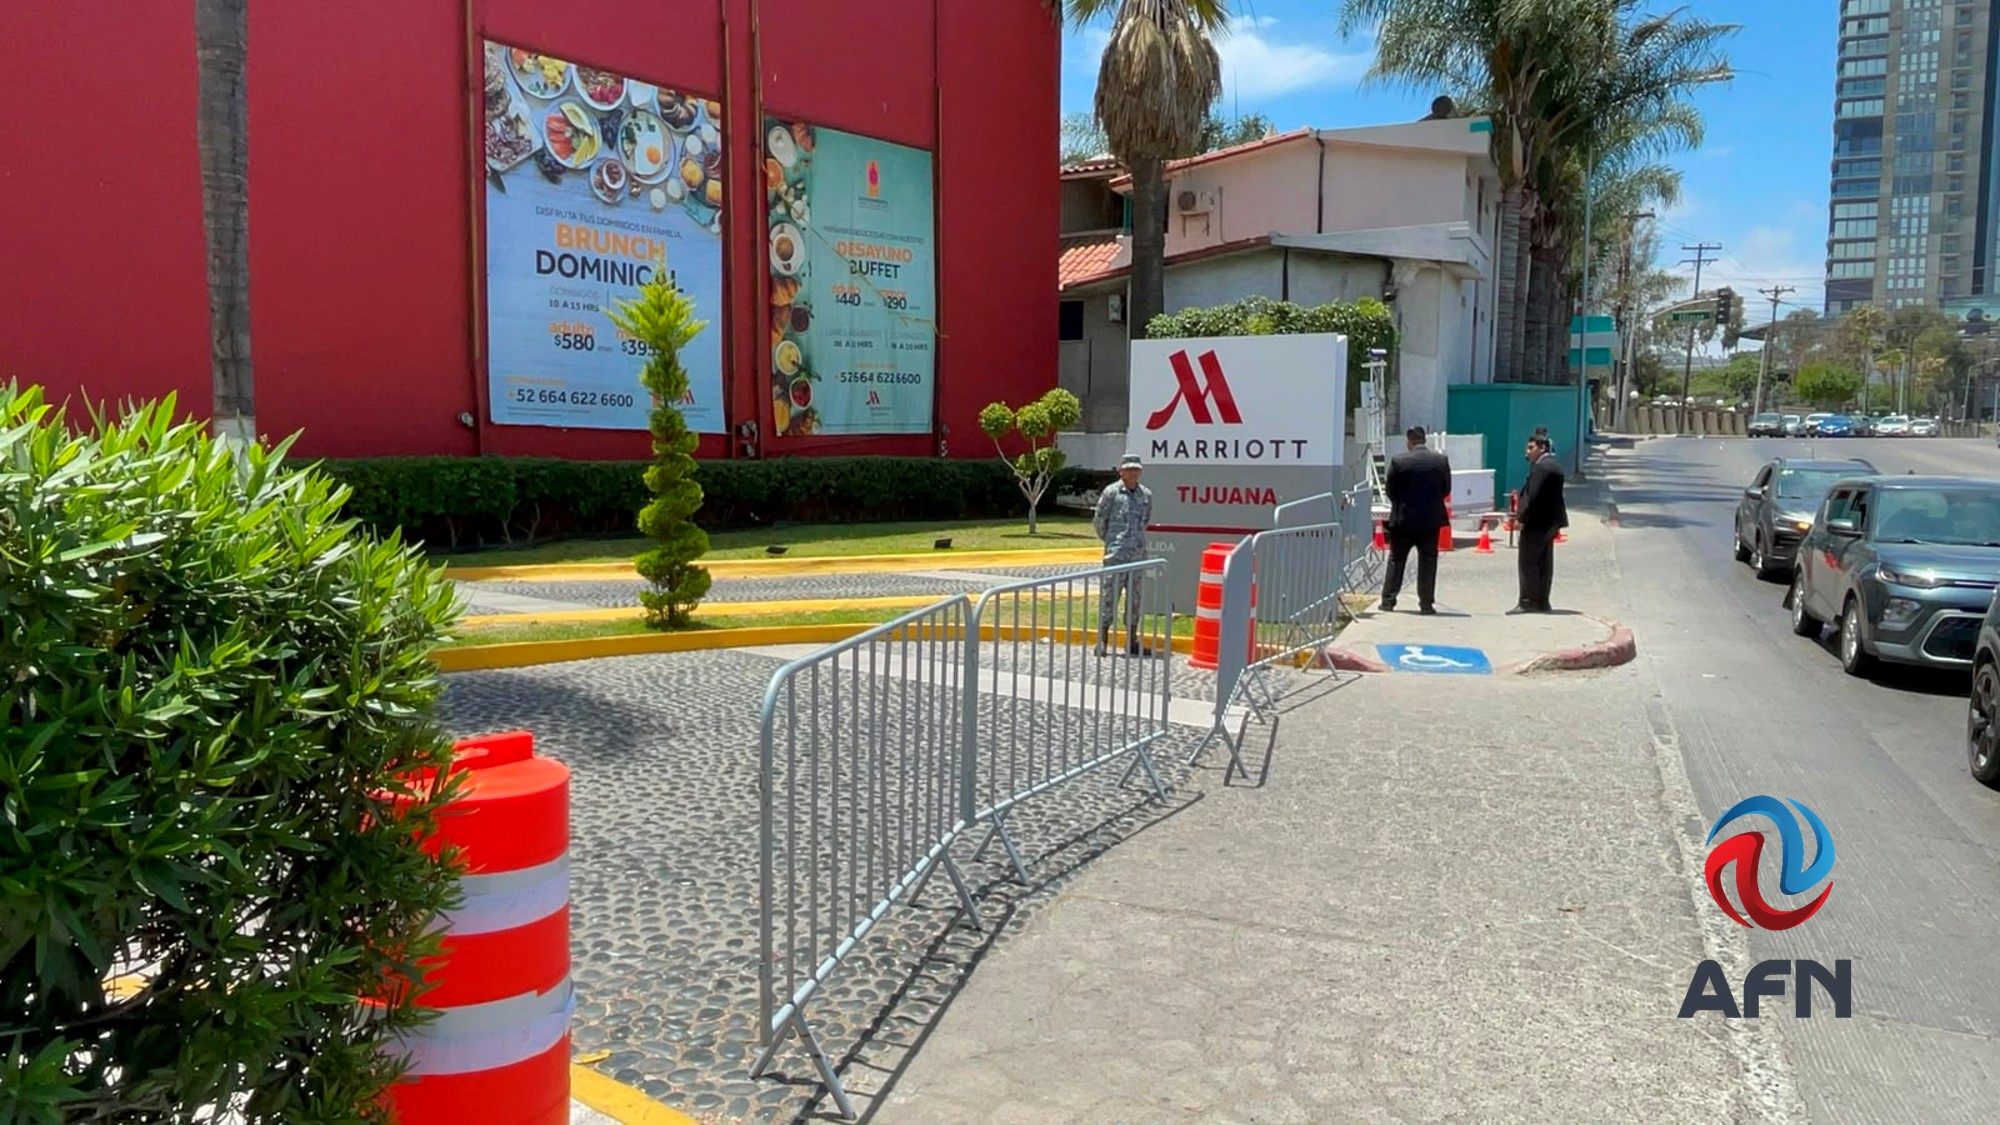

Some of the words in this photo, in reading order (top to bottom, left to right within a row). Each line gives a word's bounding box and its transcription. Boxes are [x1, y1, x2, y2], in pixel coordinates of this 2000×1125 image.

[556, 223, 666, 262] BRUNCH
[836, 240, 913, 264] DESAYUNO
[536, 249, 684, 293] DOMINICL
[849, 259, 902, 279] BUFFET
[549, 299, 560, 308] 10
[562, 300, 569, 309] A
[554, 333, 595, 352] $580
[538, 389, 567, 404] 664
[570, 391, 598, 405] 622
[600, 393, 634, 407] 6600
[1151, 439, 1308, 460] MARRIOTT
[1177, 486, 1277, 506] TIJUANA
[1146, 541, 1176, 552] LIDA
